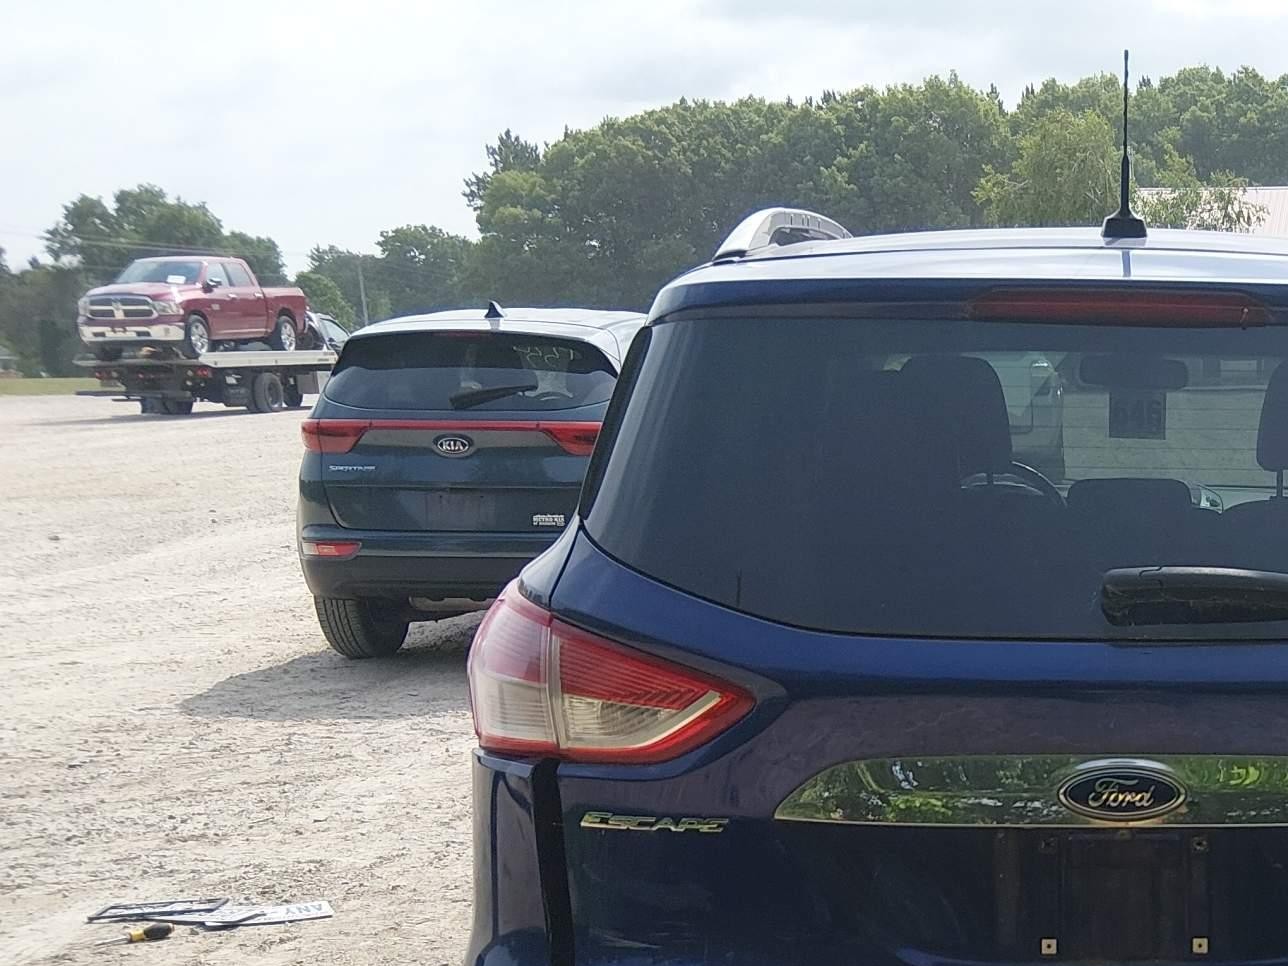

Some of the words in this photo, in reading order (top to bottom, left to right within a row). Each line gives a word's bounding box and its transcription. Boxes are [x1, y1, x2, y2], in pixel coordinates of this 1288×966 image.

[442, 440, 464, 451] KIA
[1088, 778, 1156, 807] Ford
[580, 811, 729, 833] ESCAPE
